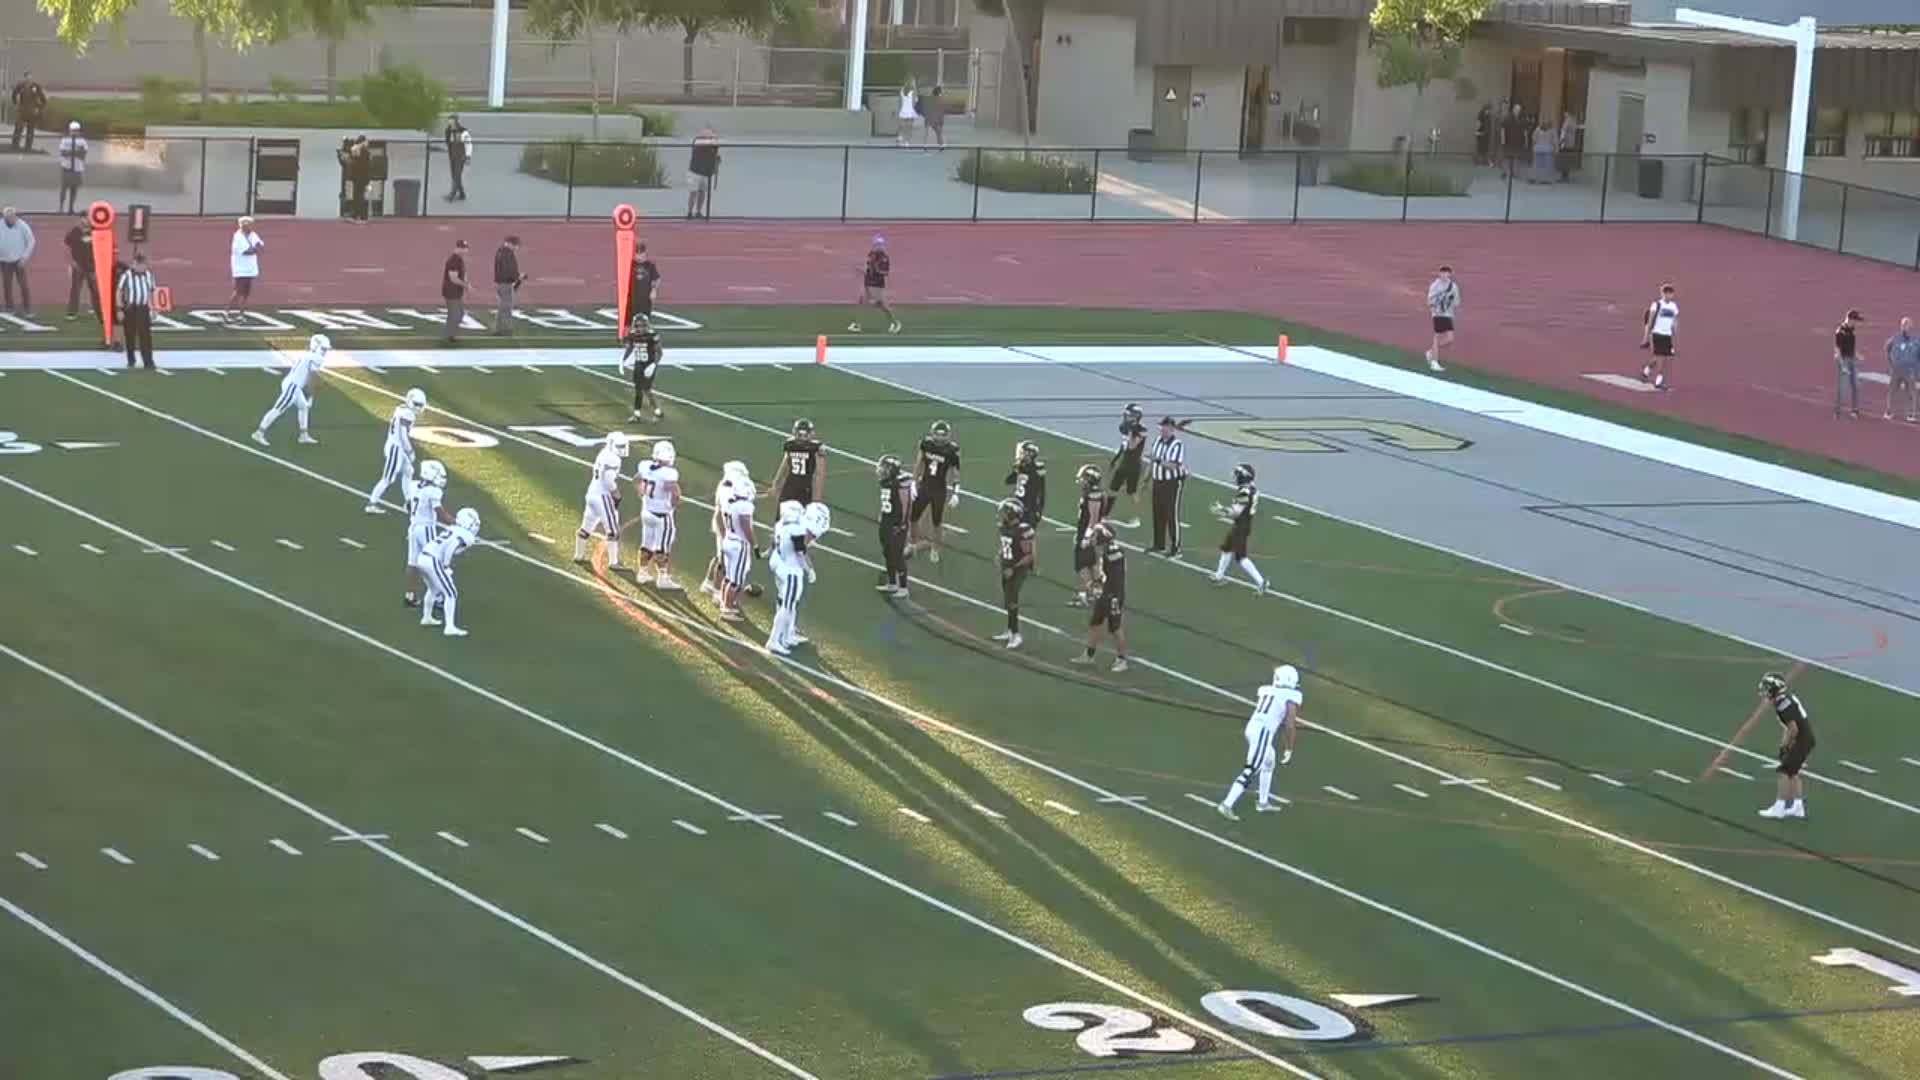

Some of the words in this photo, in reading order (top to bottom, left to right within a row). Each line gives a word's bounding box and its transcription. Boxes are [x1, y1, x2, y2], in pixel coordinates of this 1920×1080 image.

[791, 457, 807, 476] 51
[1257, 694, 1276, 715] 11
[1022, 990, 1357, 1057] 20
